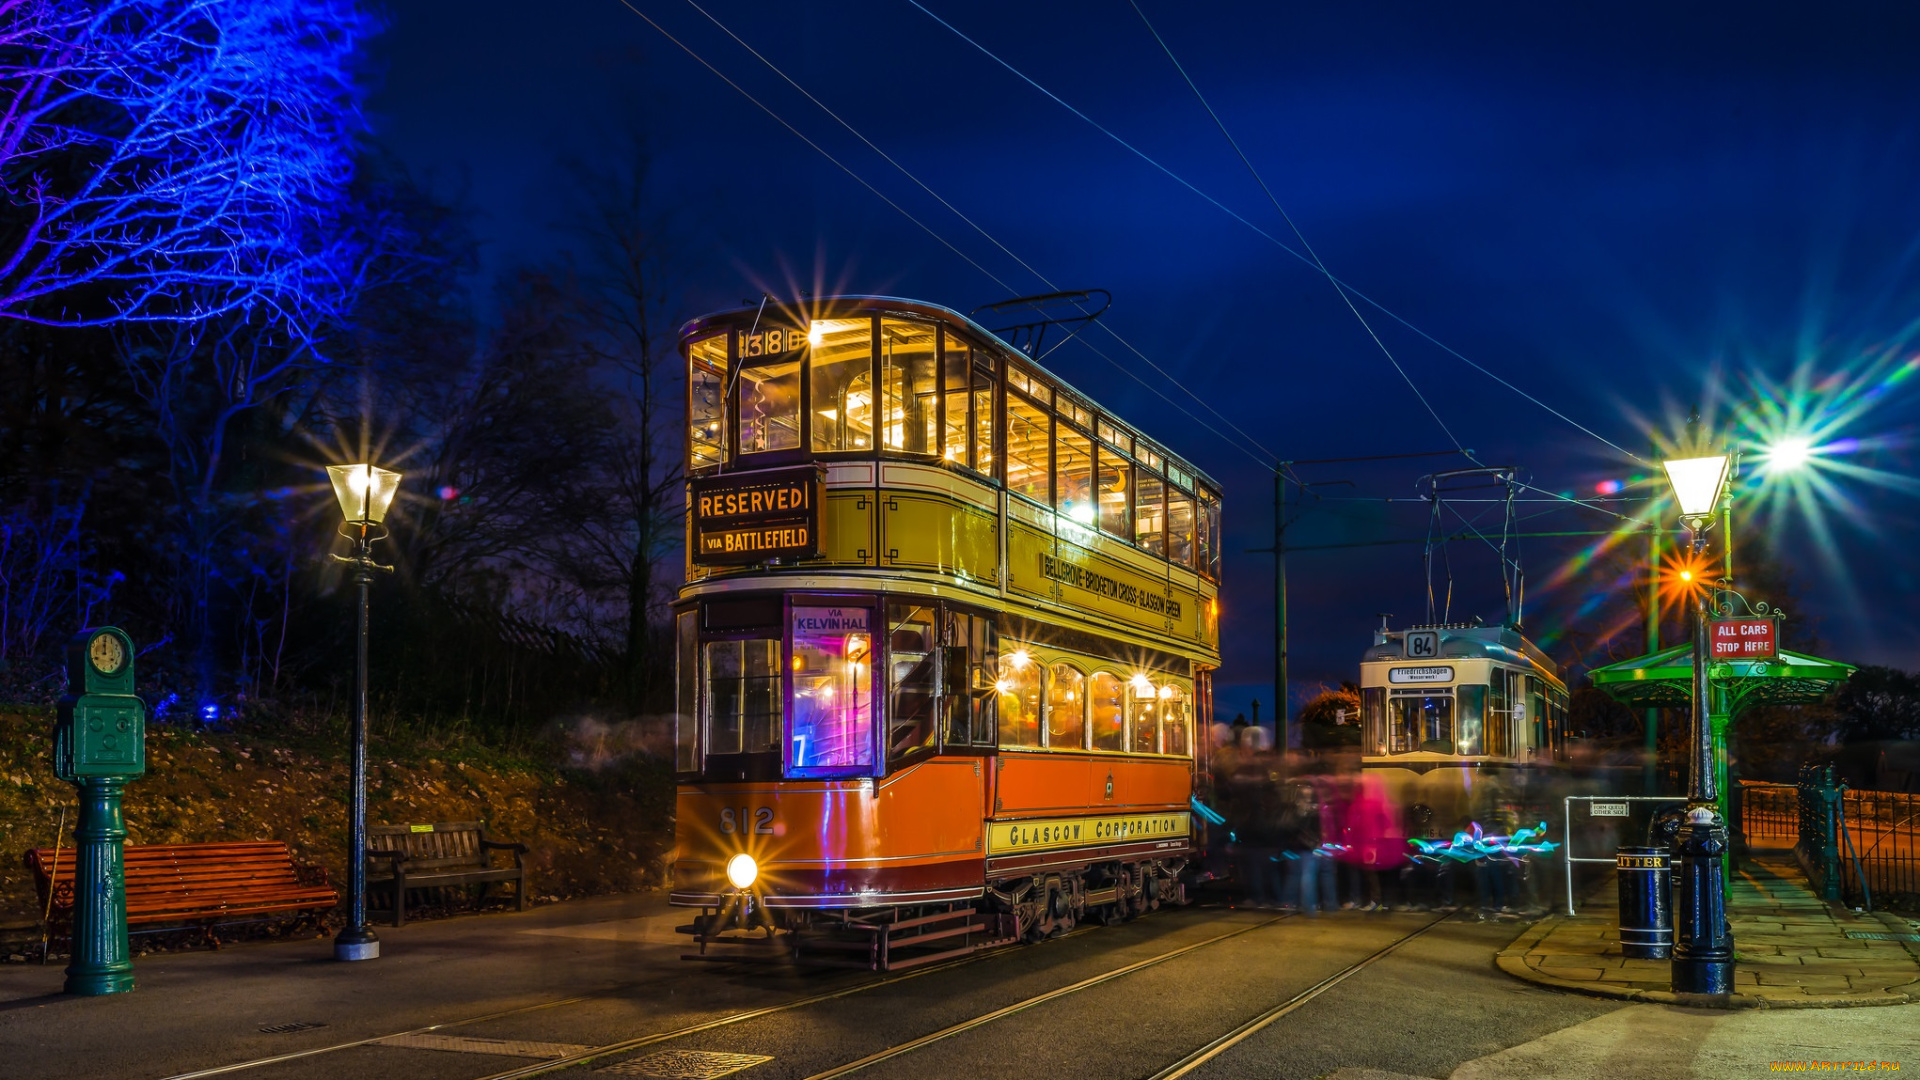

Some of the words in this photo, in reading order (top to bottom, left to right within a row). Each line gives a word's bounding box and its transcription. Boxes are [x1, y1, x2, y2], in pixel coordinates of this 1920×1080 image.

[701, 488, 802, 517] RESERVED
[707, 538, 722, 549] VIA
[725, 528, 808, 552] BATTLEFIELD
[828, 609, 843, 617] VIA
[1166, 599, 1181, 618] GREEN
[798, 618, 839, 629] KELVIN
[1718, 626, 1737, 636] ALL
[1740, 625, 1768, 636] CARS
[1414, 637, 1431, 655] 84
[1716, 642, 1740, 653] STOP
[1744, 641, 1770, 652] HERE
[719, 807, 774, 834] 812
[1010, 824, 1080, 846] GLASGOW
[1096, 819, 1176, 837] CORPORATION
